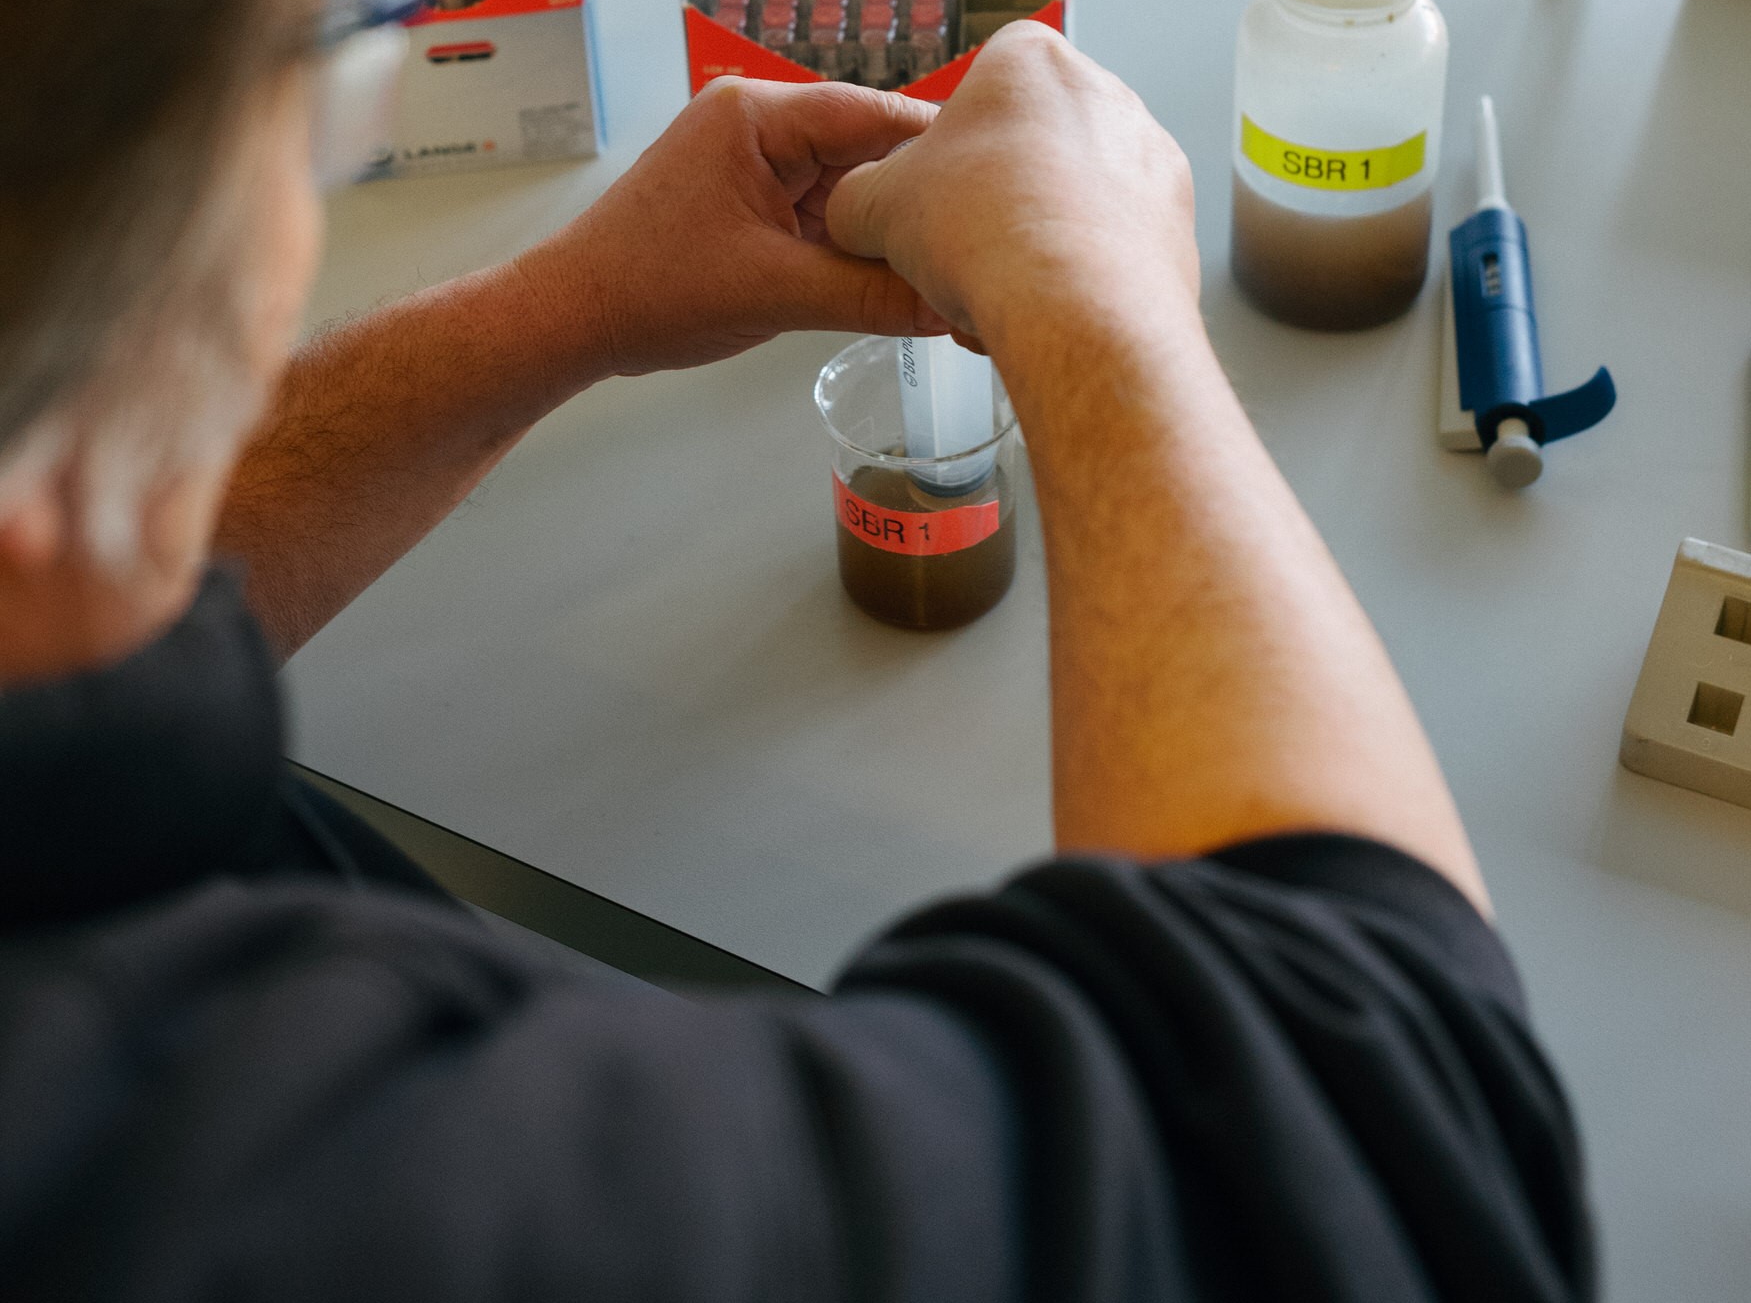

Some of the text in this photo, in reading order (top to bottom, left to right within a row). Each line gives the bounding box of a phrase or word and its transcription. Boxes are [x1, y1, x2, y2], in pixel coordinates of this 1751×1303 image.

[1283, 150, 1371, 182] SBR 1
[902, 353, 916, 374] BD
[846, 498, 930, 544] SBR 1
